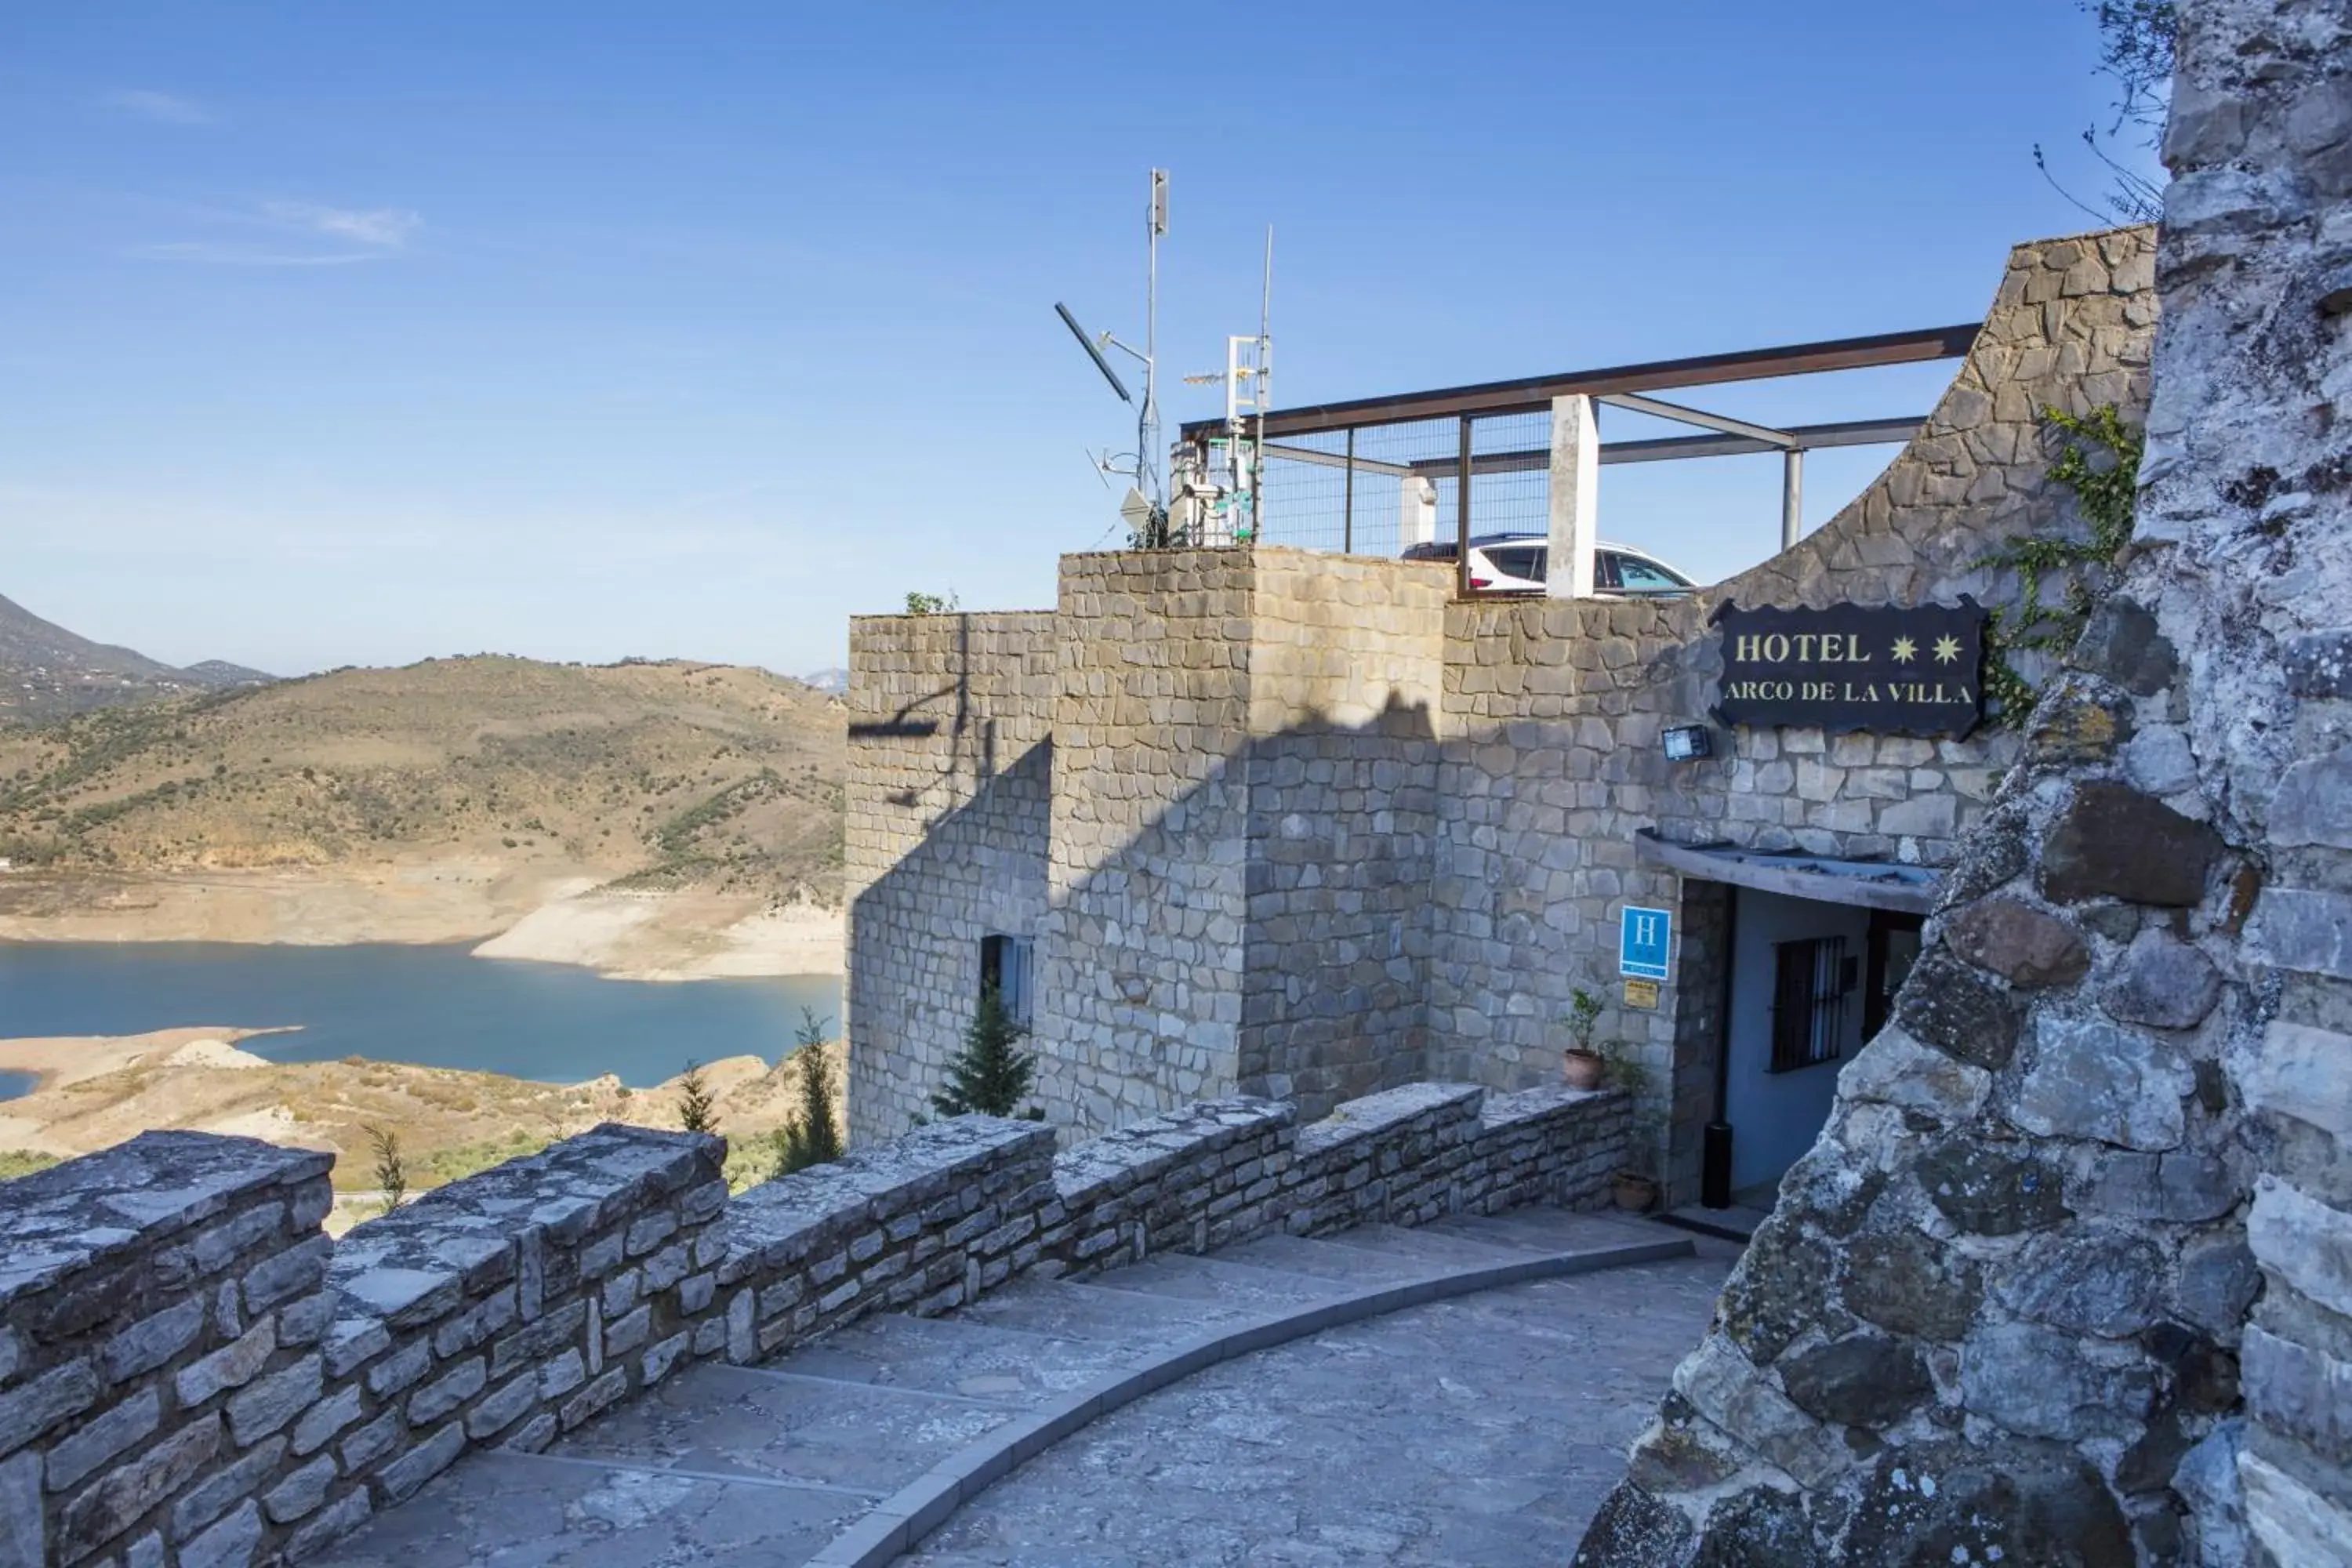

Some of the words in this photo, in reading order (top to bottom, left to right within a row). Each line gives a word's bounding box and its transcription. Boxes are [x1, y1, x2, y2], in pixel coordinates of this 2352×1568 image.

[1734, 633, 1871, 662] HOTEL
[1725, 681, 1793, 700] ARCO
[1802, 682, 1836, 701] DE
[1843, 683, 1880, 702] LA
[1888, 683, 1973, 704] VILLA
[1634, 915, 1657, 946] H
